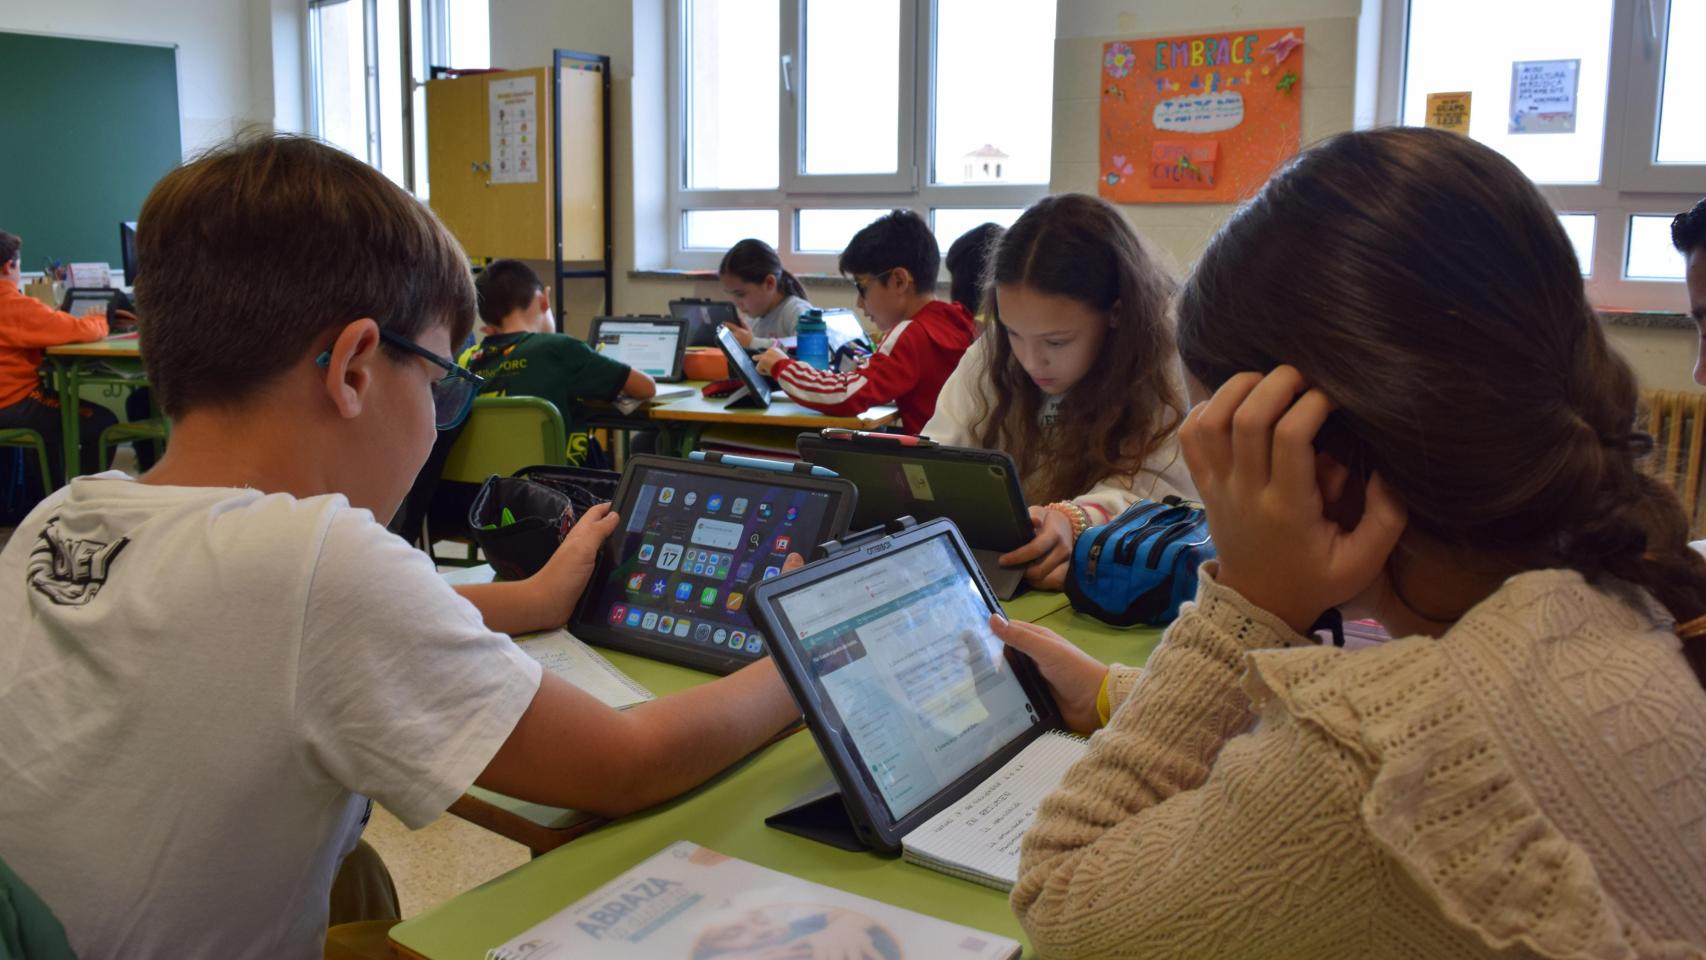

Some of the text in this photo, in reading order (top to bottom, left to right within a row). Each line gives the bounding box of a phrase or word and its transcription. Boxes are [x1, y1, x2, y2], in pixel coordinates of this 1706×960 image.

[1156, 35, 1258, 71] EMBRACE
[663, 551, 679, 567] 17
[575, 876, 684, 940] ABRAZA
